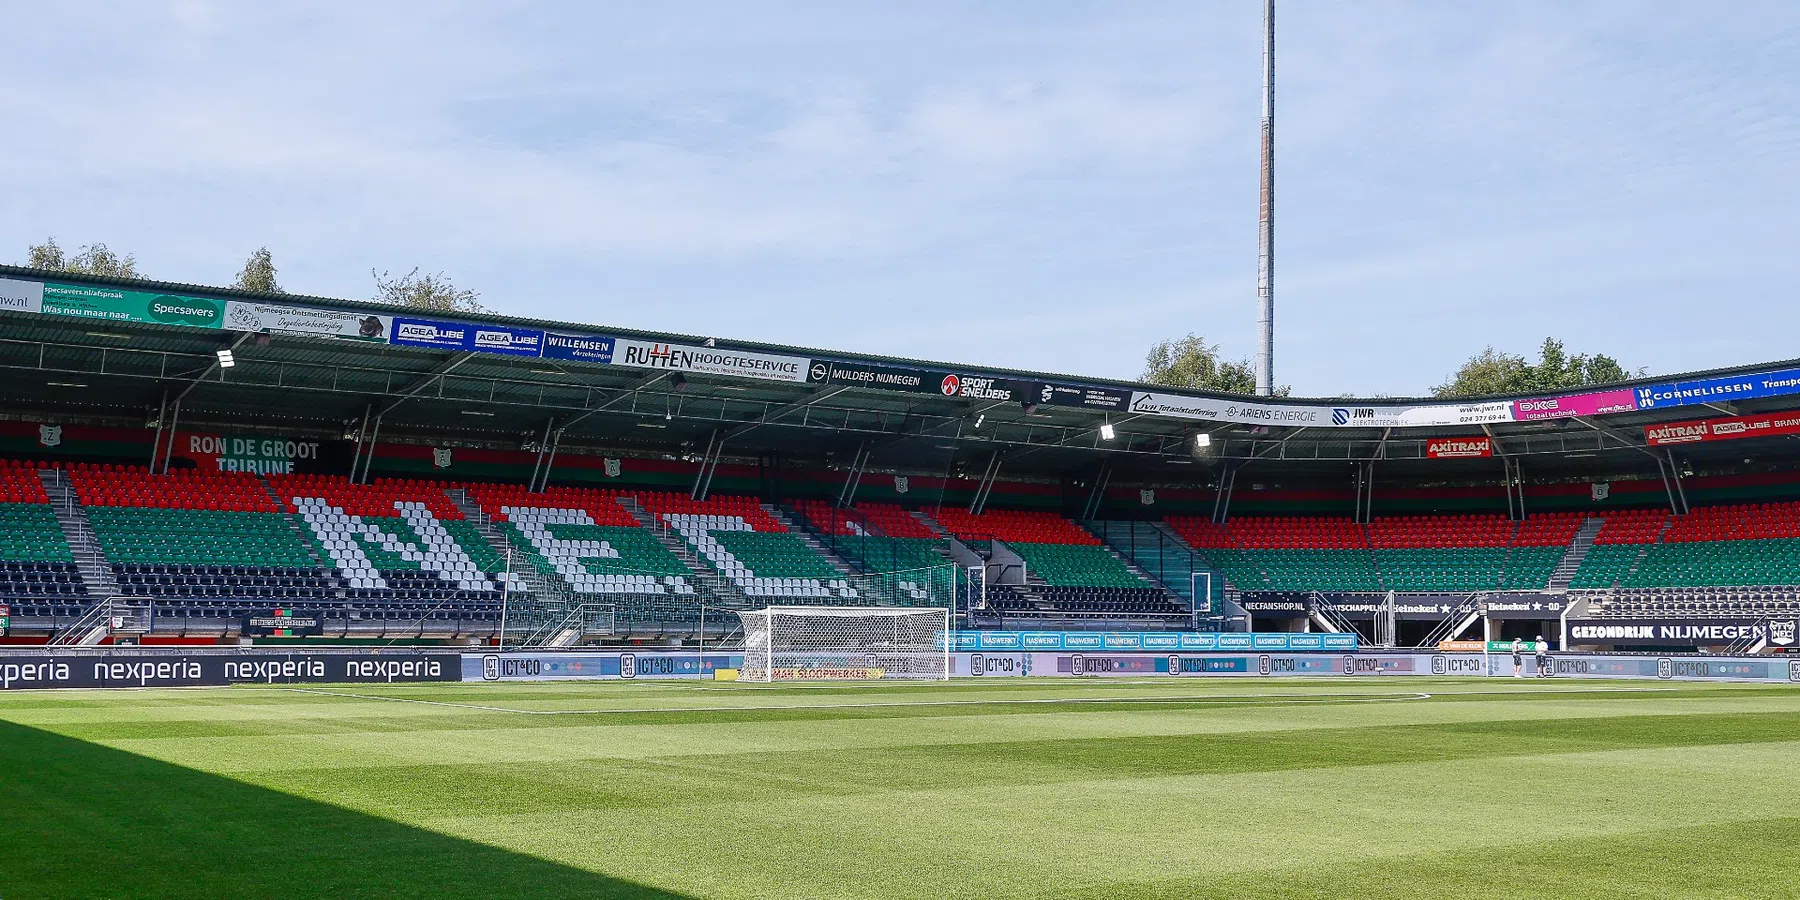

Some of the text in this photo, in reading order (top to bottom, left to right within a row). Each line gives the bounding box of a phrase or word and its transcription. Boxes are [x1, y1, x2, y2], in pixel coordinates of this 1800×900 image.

[45, 286, 124, 300] specsavers.nl/afspraak
[43, 304, 62, 313] Was
[64, 307, 82, 315] nou
[84, 309, 108, 318] maar
[109, 311, 130, 319] naar
[153, 303, 214, 318] Specsavers
[254, 305, 357, 322] Nijmeegse Ontsmettingsdienst
[547, 337, 609, 352] WILLEMSEN
[625, 343, 693, 369] RUTTEN
[695, 354, 799, 374] HOOGTESERVICE
[832, 369, 921, 387] MULDERS NIJMEGEN
[960, 377, 995, 389] SPORT
[960, 388, 1011, 401] SNELDERS
[1653, 382, 1753, 401] CORNELISSEN
[1139, 403, 1158, 411] JVH
[1459, 403, 1505, 414] www.jwr.nl
[1519, 399, 1559, 411] DKC
[1239, 408, 1316, 422] ARIENS ENERGIE
[1353, 408, 1374, 419] JWR
[1353, 419, 1409, 427] ELEKTROTECHNIEK
[1774, 418, 1800, 428] BRAN
[190, 435, 319, 460] RON DE GROOT
[216, 457, 295, 476] TRIBUNE
[1245, 602, 1305, 611] NECFANSHOP.NL
[1393, 603, 1438, 613] Heineken
[1487, 601, 1531, 611] Heineken
[1571, 625, 1766, 639] GEZONDRIJK NIJMEGEN
[1773, 630, 1792, 639] NEC
[224, 656, 325, 684] nexperia
[346, 656, 441, 682] nexperia
[502, 659, 541, 676] ICT&CO
[638, 658, 674, 674] ICT&CO
[985, 658, 1014, 672] ICT&CO
[1085, 658, 1112, 672] ICT&CO
[1271, 658, 1295, 671] ICT&CO
[1448, 659, 1480, 671] ICT&CO
[1557, 660, 1587, 673] ICT&CO
[1674, 662, 1709, 676] ICT&CO
[94, 658, 202, 686] nexperia
